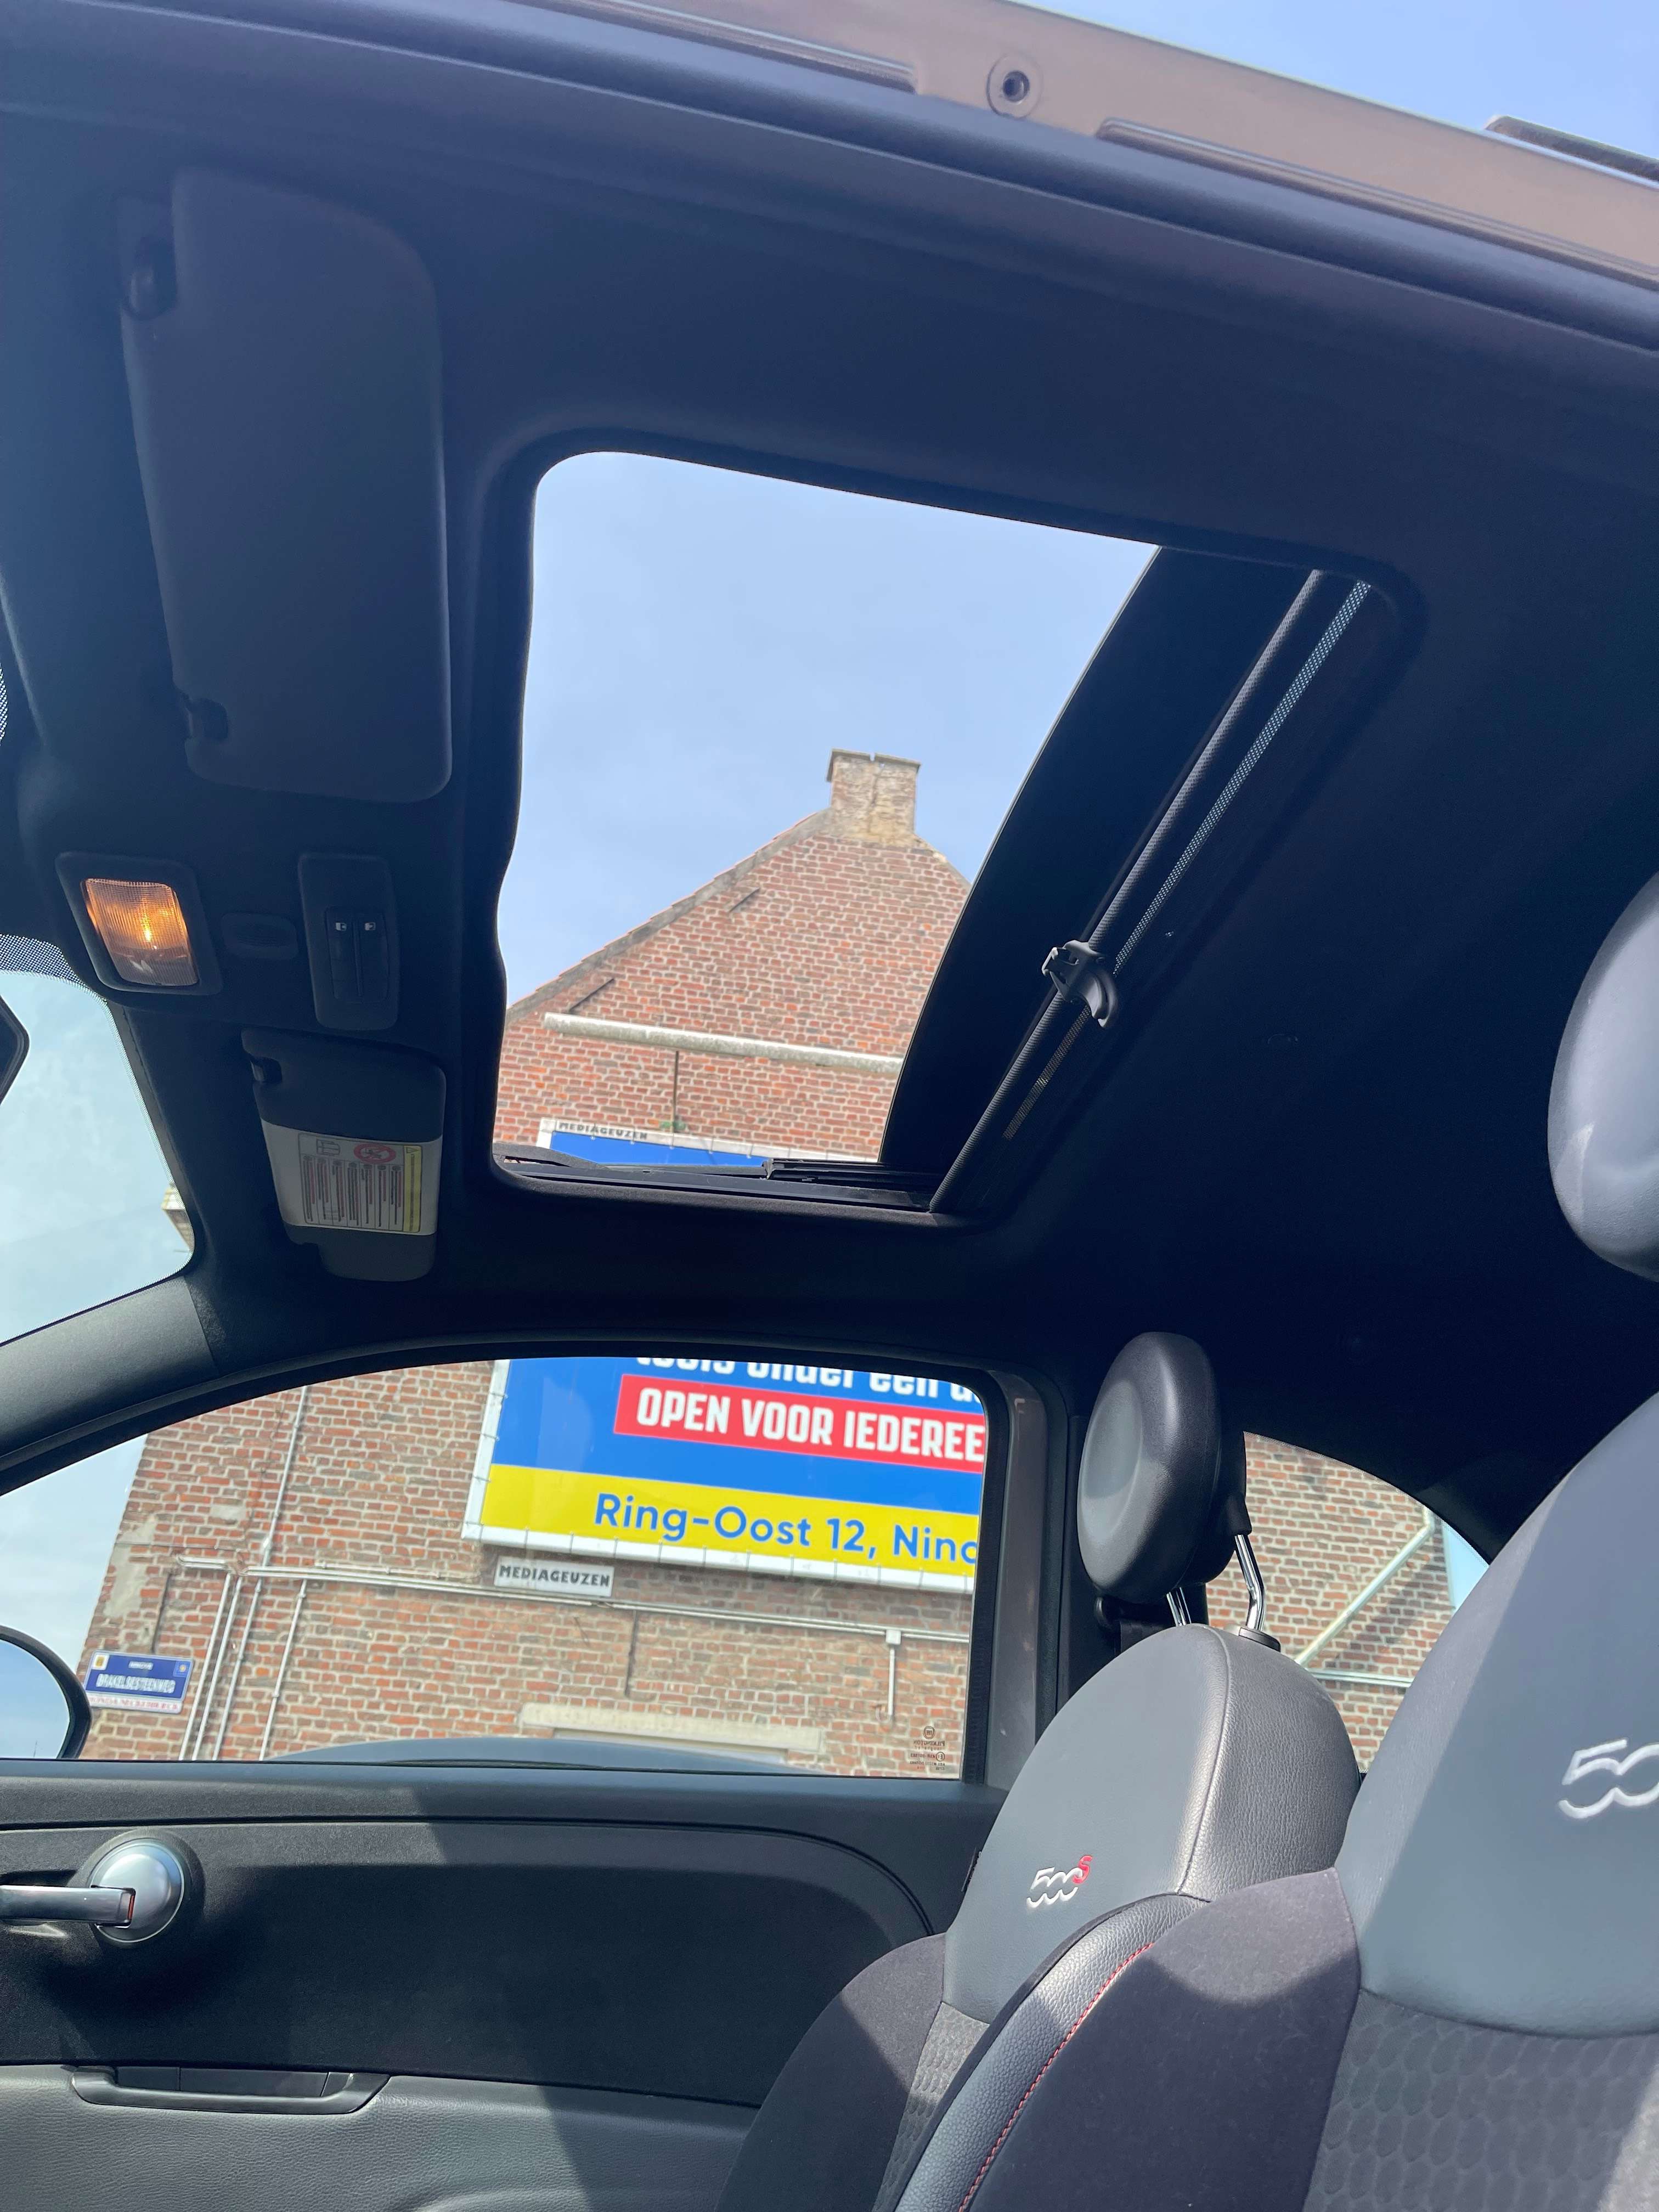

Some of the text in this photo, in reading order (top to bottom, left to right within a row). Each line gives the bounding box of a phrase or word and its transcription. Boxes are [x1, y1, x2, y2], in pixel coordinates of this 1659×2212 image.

[559, 1122, 648, 1139] MEDIAGEUZEN
[636, 1387, 986, 1463] OPEN VOOR IEDEREE
[594, 1493, 811, 1547] Ring-Oost
[826, 1517, 876, 1560] 12,
[499, 1565, 610, 1587] MEDIAGEUZEN
